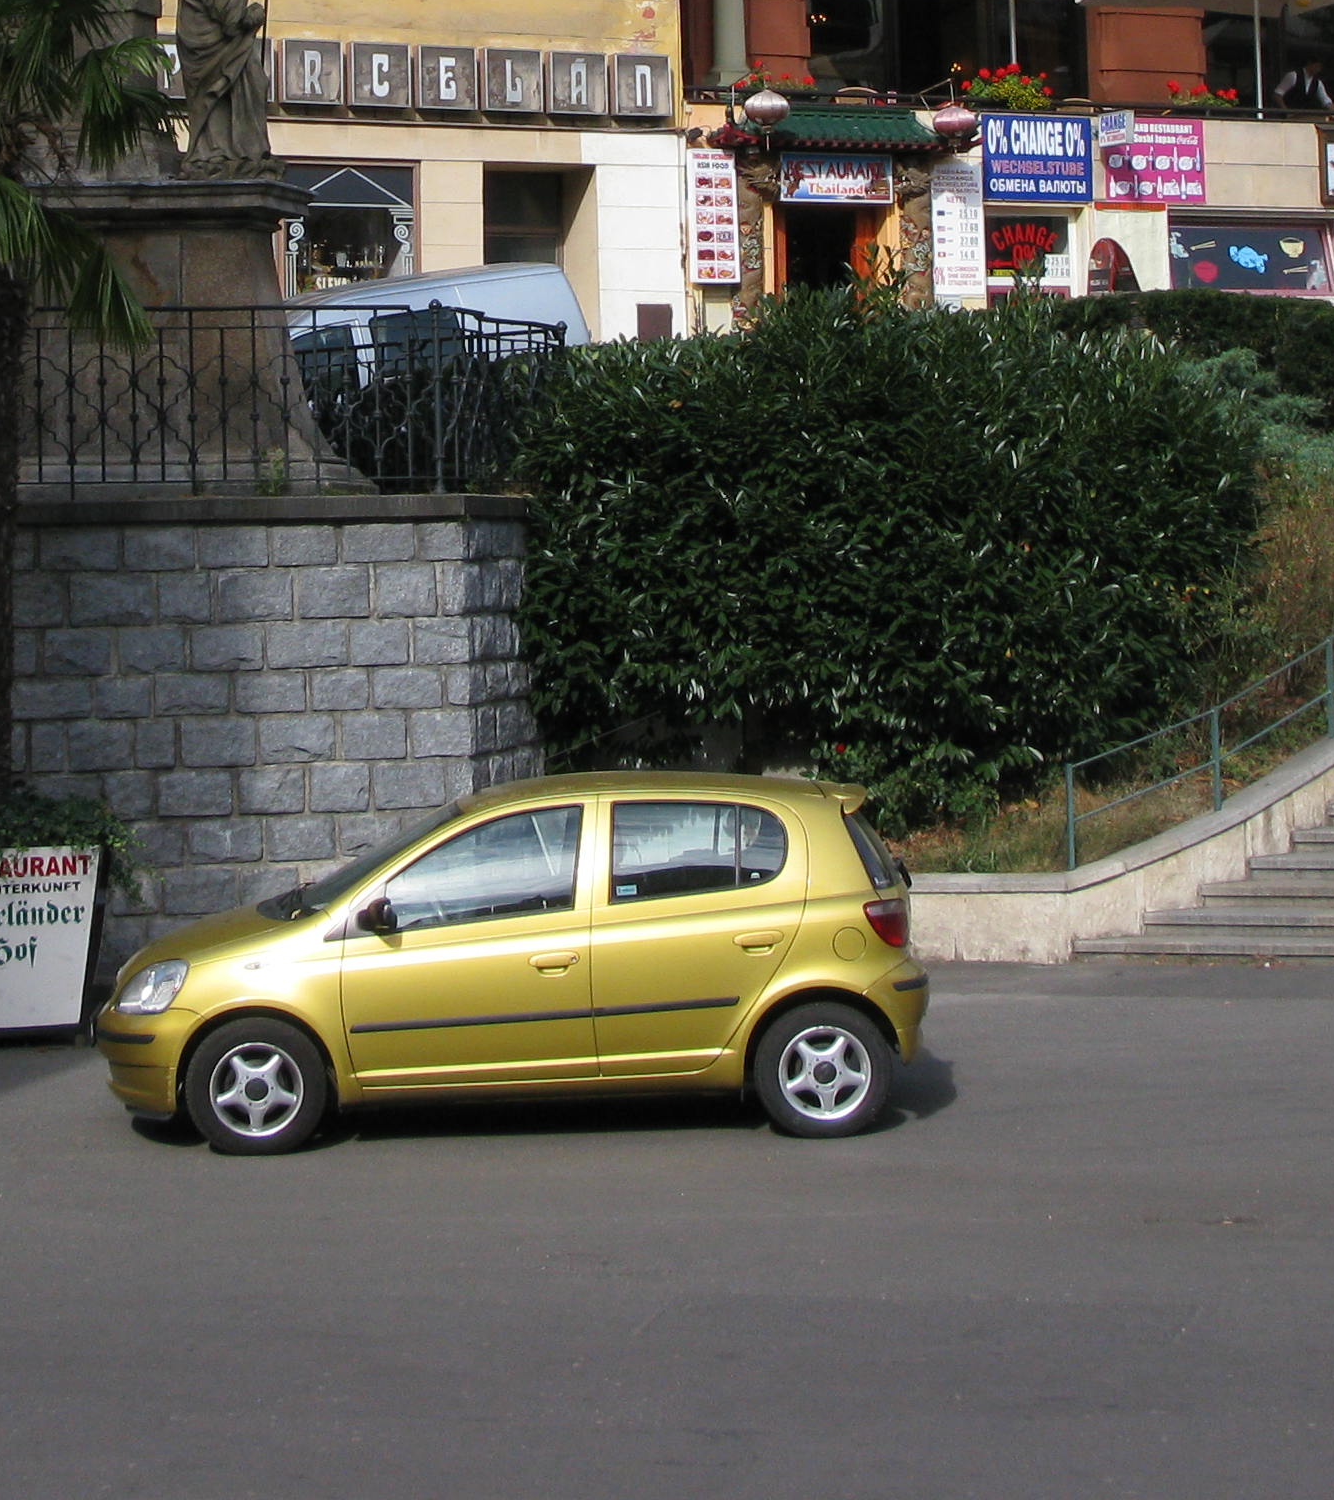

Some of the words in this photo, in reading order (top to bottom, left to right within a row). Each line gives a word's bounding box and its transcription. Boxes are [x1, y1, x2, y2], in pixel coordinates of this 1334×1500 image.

[987, 118, 1008, 154] 0%
[1010, 120, 1064, 156] CHANGE
[1066, 122, 1085, 157] 0%
[991, 160, 1084, 176] WECHSELSTUBE
[989, 178, 1036, 193] ОБМЕНА
[1039, 179, 1086, 194] ВАЛЮТЫ
[991, 223, 1059, 252] CHANGE
